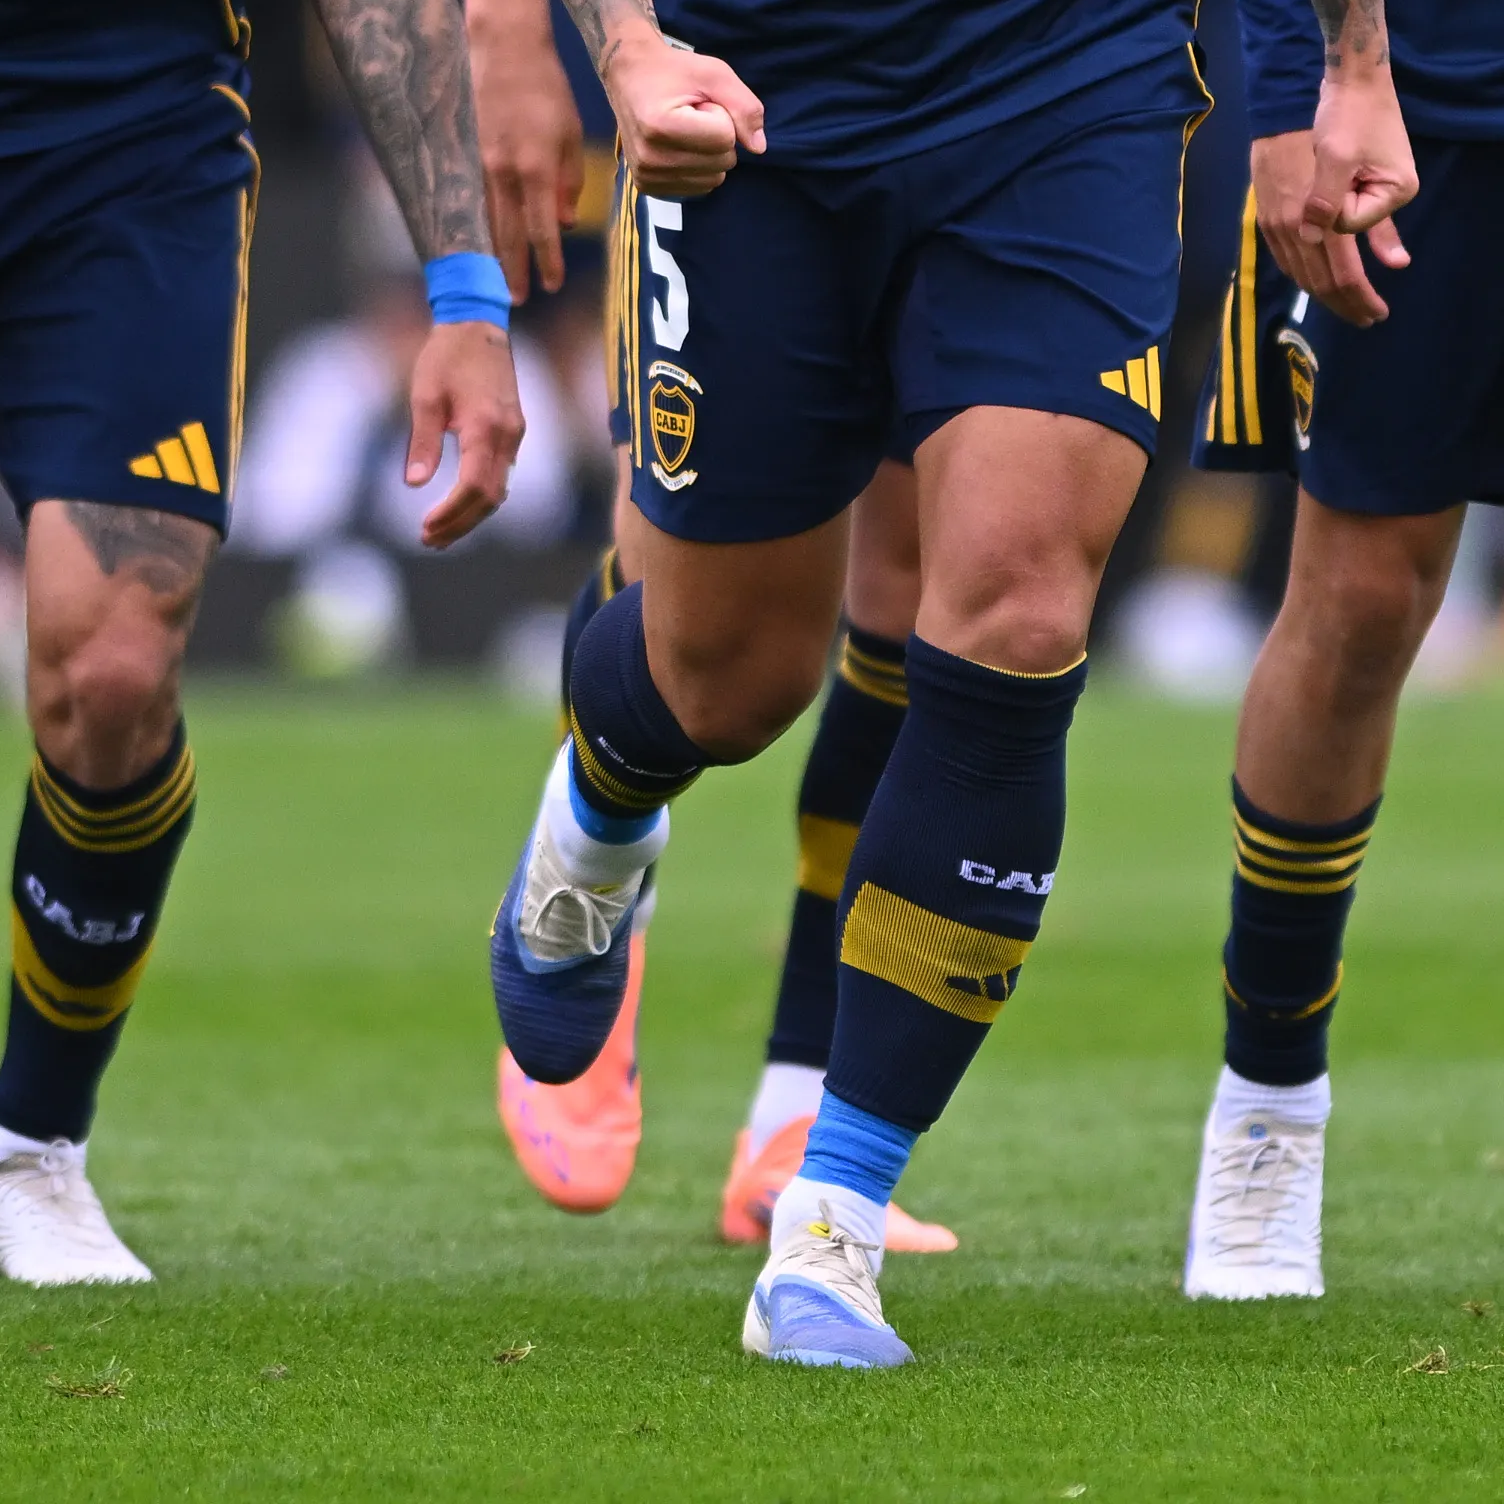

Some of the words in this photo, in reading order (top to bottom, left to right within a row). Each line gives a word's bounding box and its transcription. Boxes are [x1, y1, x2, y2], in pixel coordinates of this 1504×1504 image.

[646, 195, 689, 352] 5
[656, 412, 686, 433] CABJ
[25, 873, 146, 946] CABJ
